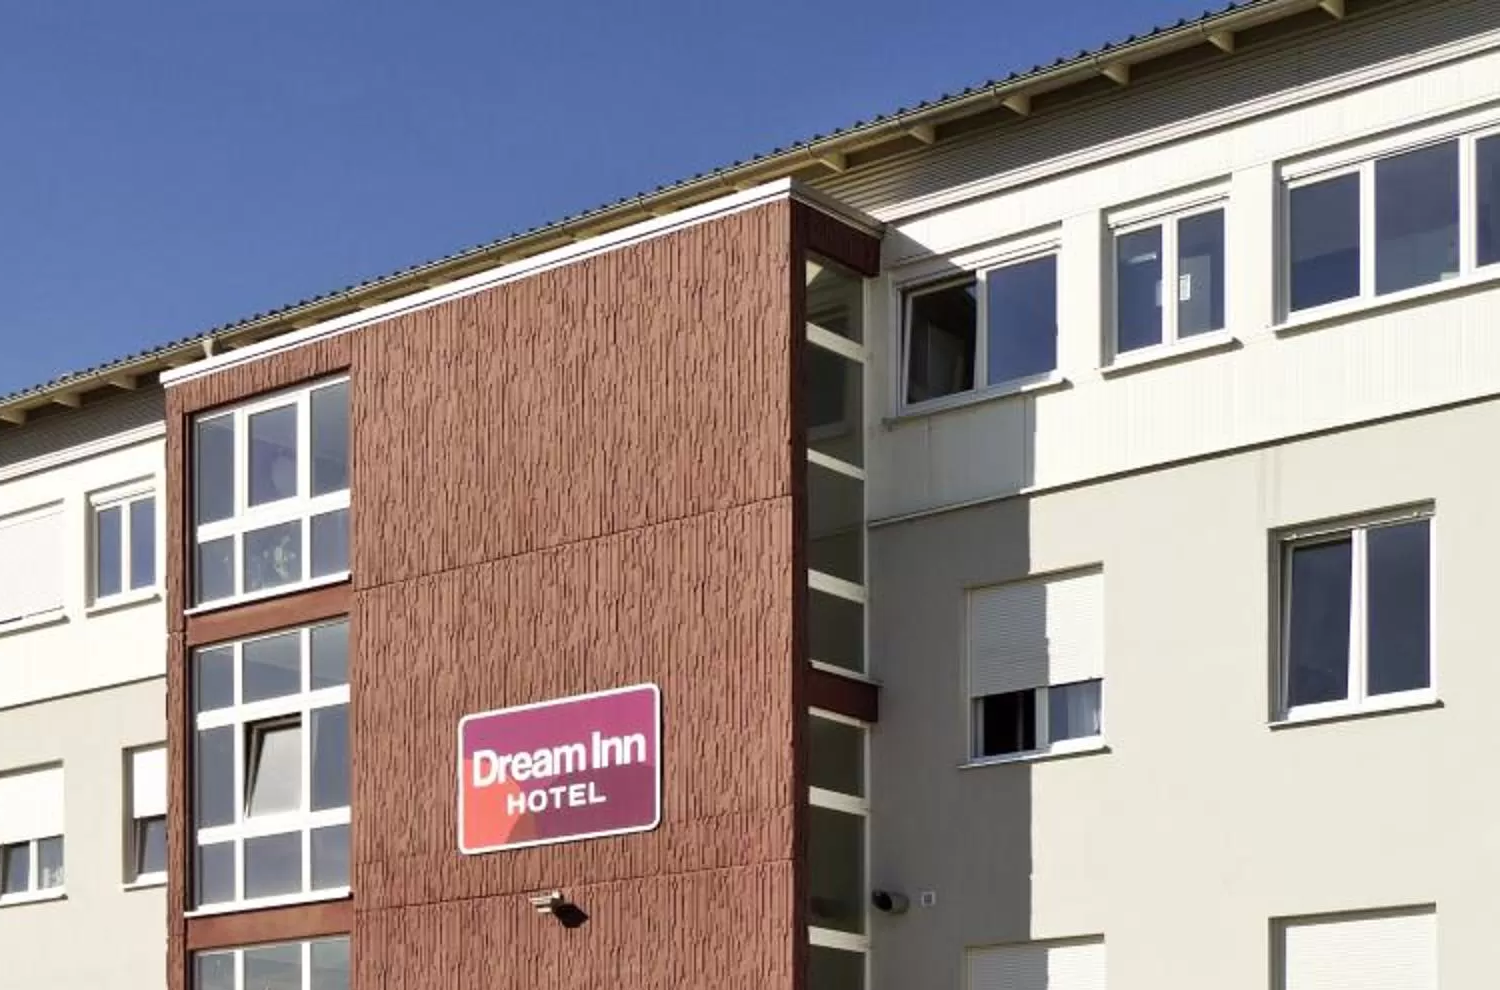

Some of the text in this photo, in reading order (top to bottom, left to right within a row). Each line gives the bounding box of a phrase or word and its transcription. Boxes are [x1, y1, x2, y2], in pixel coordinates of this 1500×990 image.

[472, 731, 647, 788] Dream Inn
[506, 781, 607, 816] HOTEL
